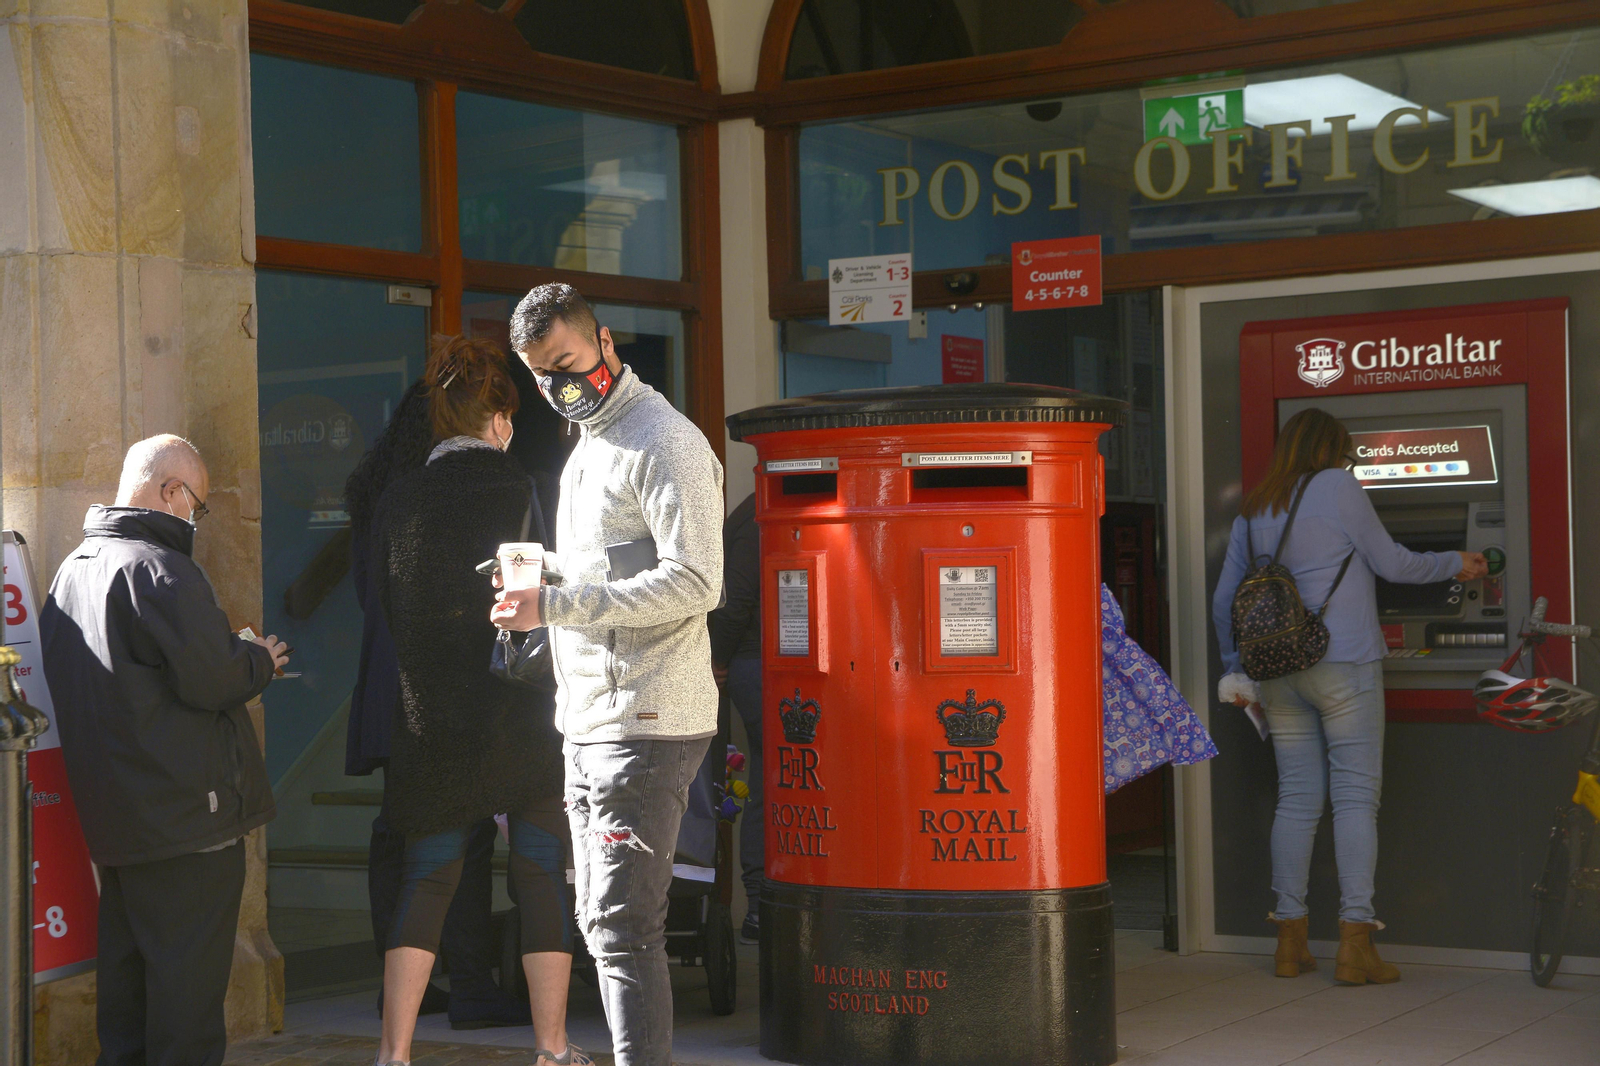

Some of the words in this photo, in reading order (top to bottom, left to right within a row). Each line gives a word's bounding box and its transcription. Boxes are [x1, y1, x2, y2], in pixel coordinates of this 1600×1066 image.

[876, 146, 1088, 228] POST
[1133, 96, 1504, 201] OFFICE
[886, 267, 909, 281] 1-3
[1030, 268, 1083, 282] Counter
[1025, 285, 1089, 301] 4-5-6-7-8
[893, 300, 903, 316] 2
[1351, 333, 1502, 370] Gibraltar
[1354, 367, 1462, 386] INTERNATIONAL
[1463, 364, 1502, 378] BANK
[1356, 444, 1394, 458] Cards
[1396, 440, 1459, 457] Accepted
[32, 791, 60, 808] ffice
[771, 802, 838, 830] ROYAL
[918, 809, 1027, 834] ROYAL
[776, 831, 829, 858] MAIL
[931, 837, 1018, 862] MAIL
[814, 964, 892, 988] MACHAN
[905, 970, 948, 990] ENG
[828, 991, 930, 1016] SCOTLAND
